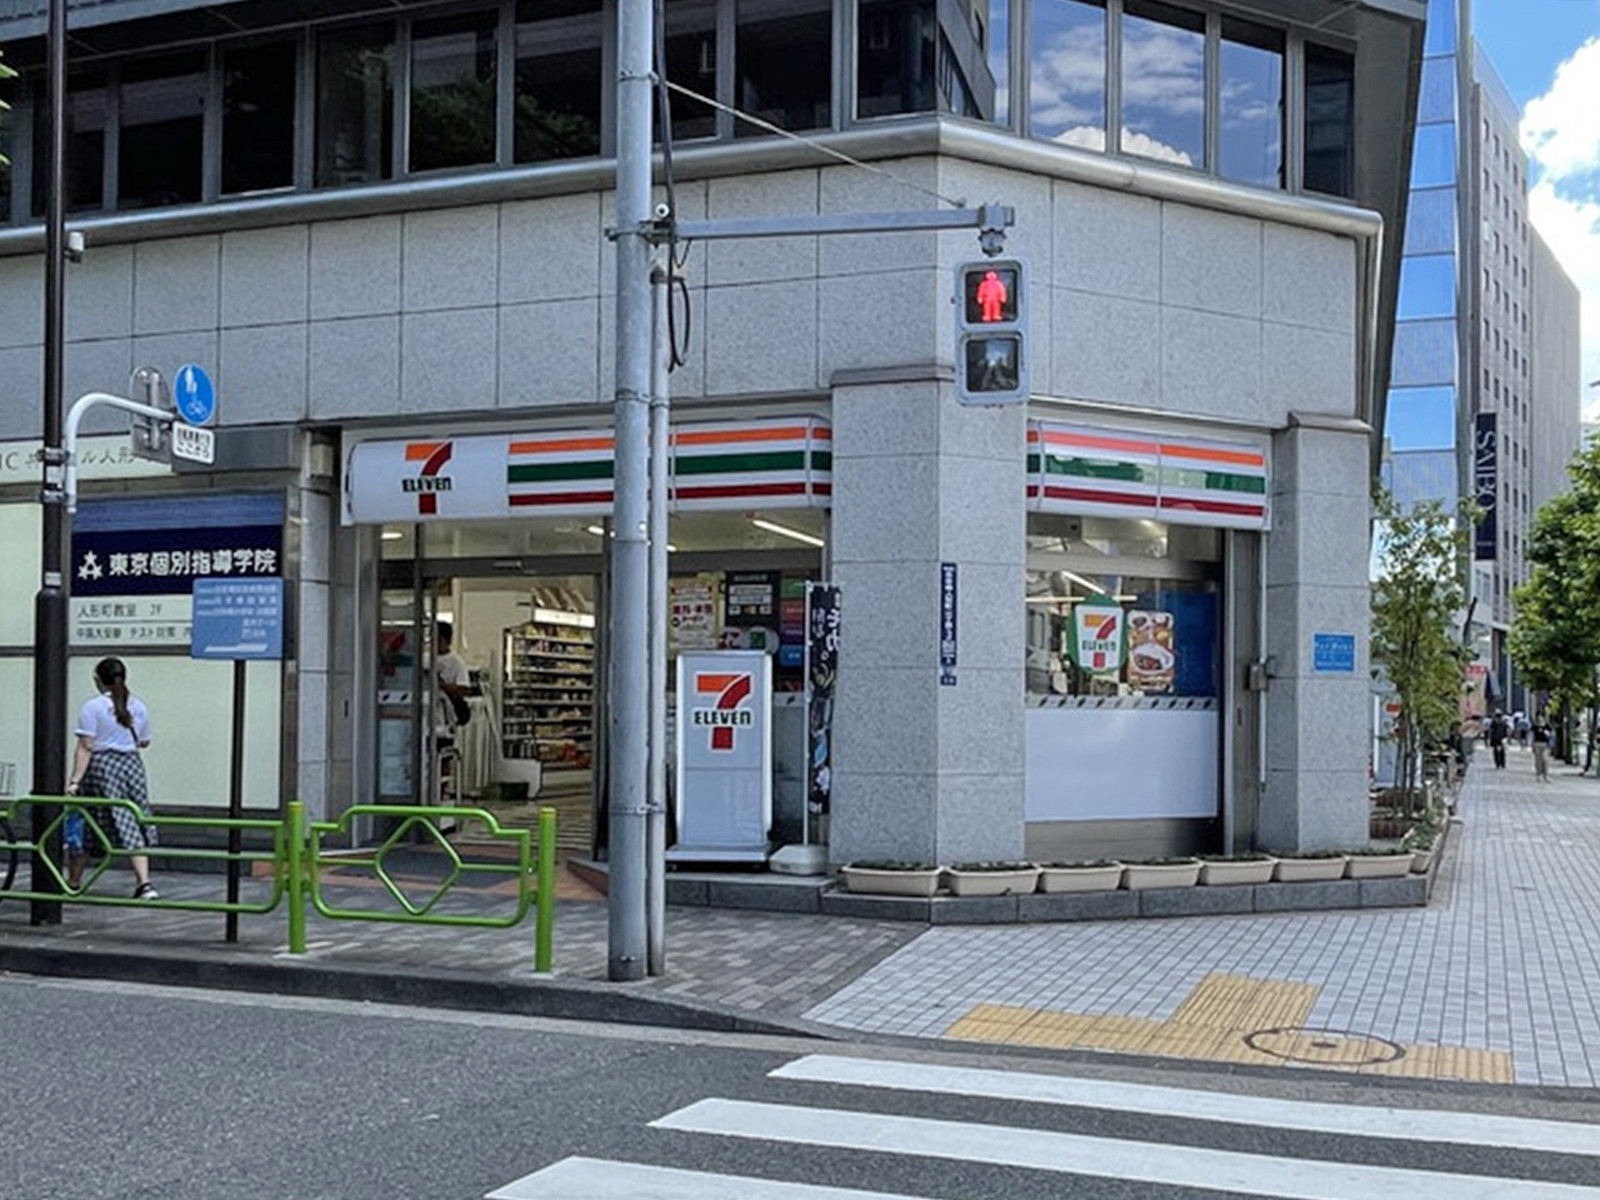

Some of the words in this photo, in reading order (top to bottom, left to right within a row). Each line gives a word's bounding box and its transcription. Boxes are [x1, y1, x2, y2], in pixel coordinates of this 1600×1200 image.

[109, 548, 277, 576] 東京個別指導学院
